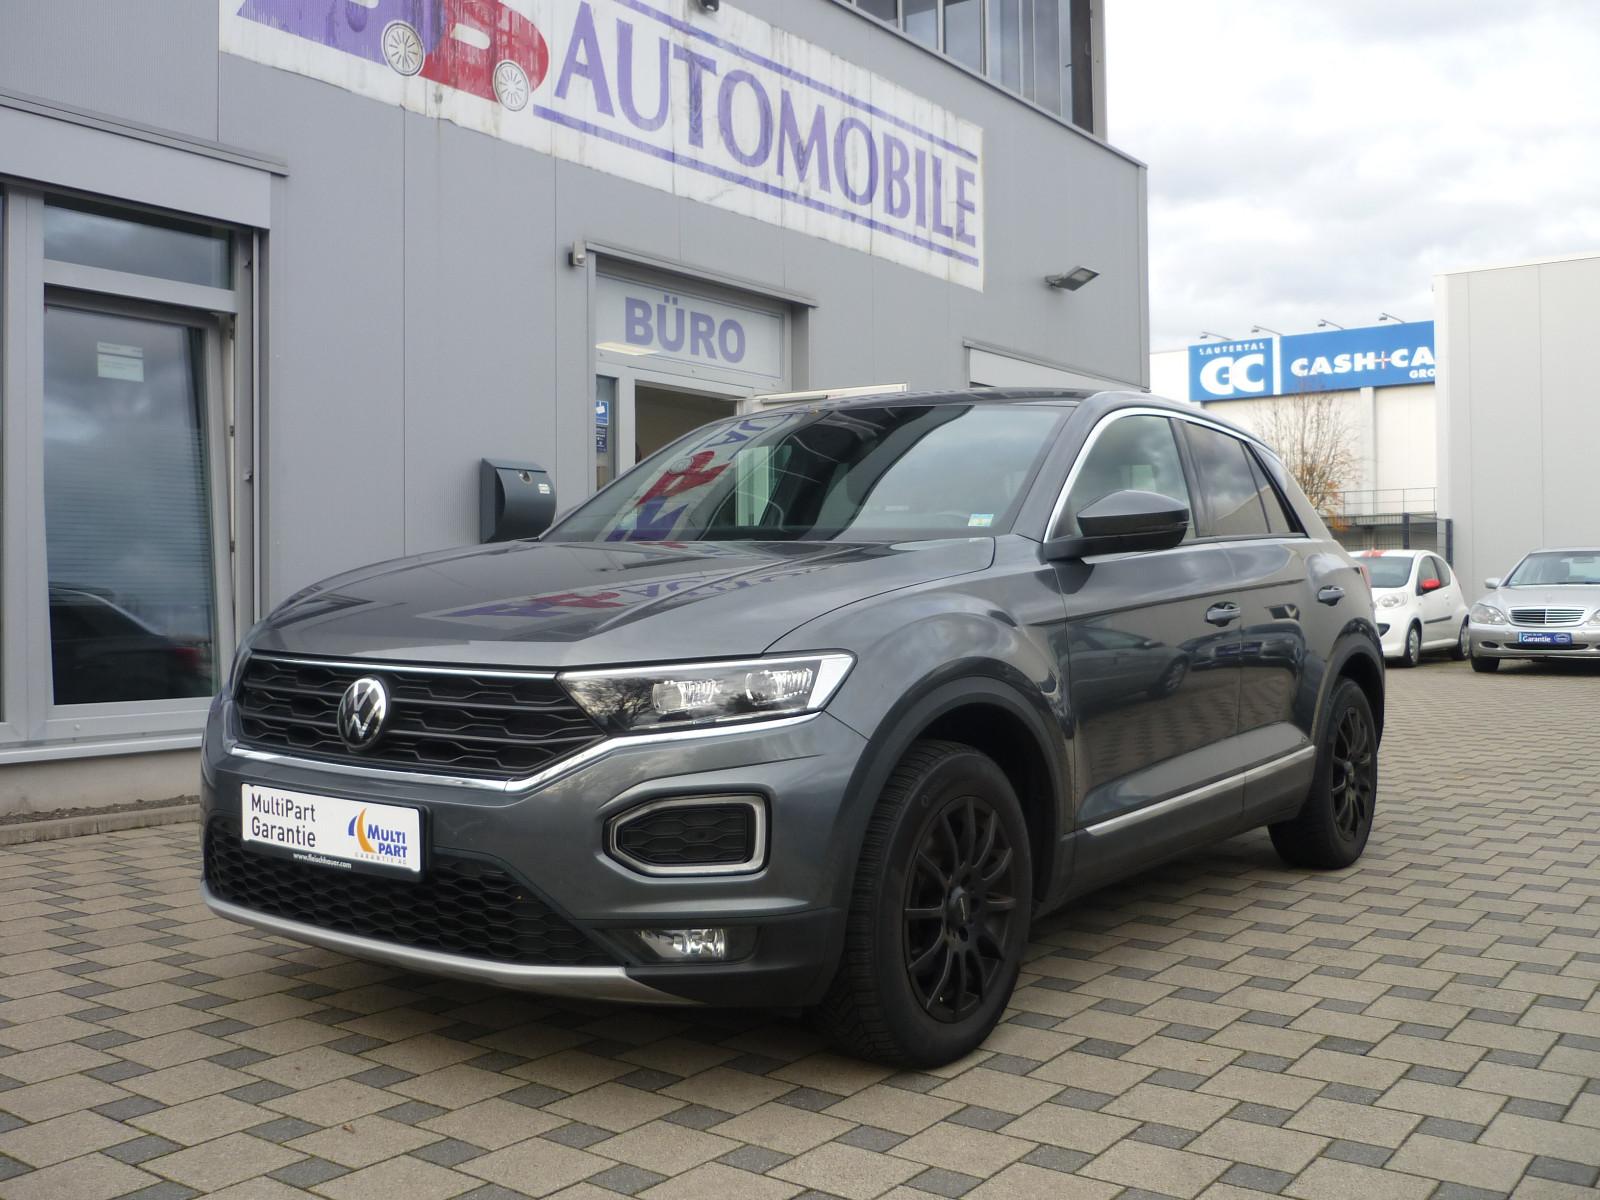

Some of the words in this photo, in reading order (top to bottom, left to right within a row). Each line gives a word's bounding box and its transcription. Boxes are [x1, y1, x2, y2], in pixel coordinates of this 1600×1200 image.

[554, 0, 977, 249] AUTOMOBILE
[625, 294, 745, 363] BÜRO
[1200, 353, 1264, 395] GC
[251, 793, 316, 823] MultiPart
[251, 816, 316, 848] Garantie
[367, 824, 406, 844] MULTI
[378, 843, 408, 858] PART
